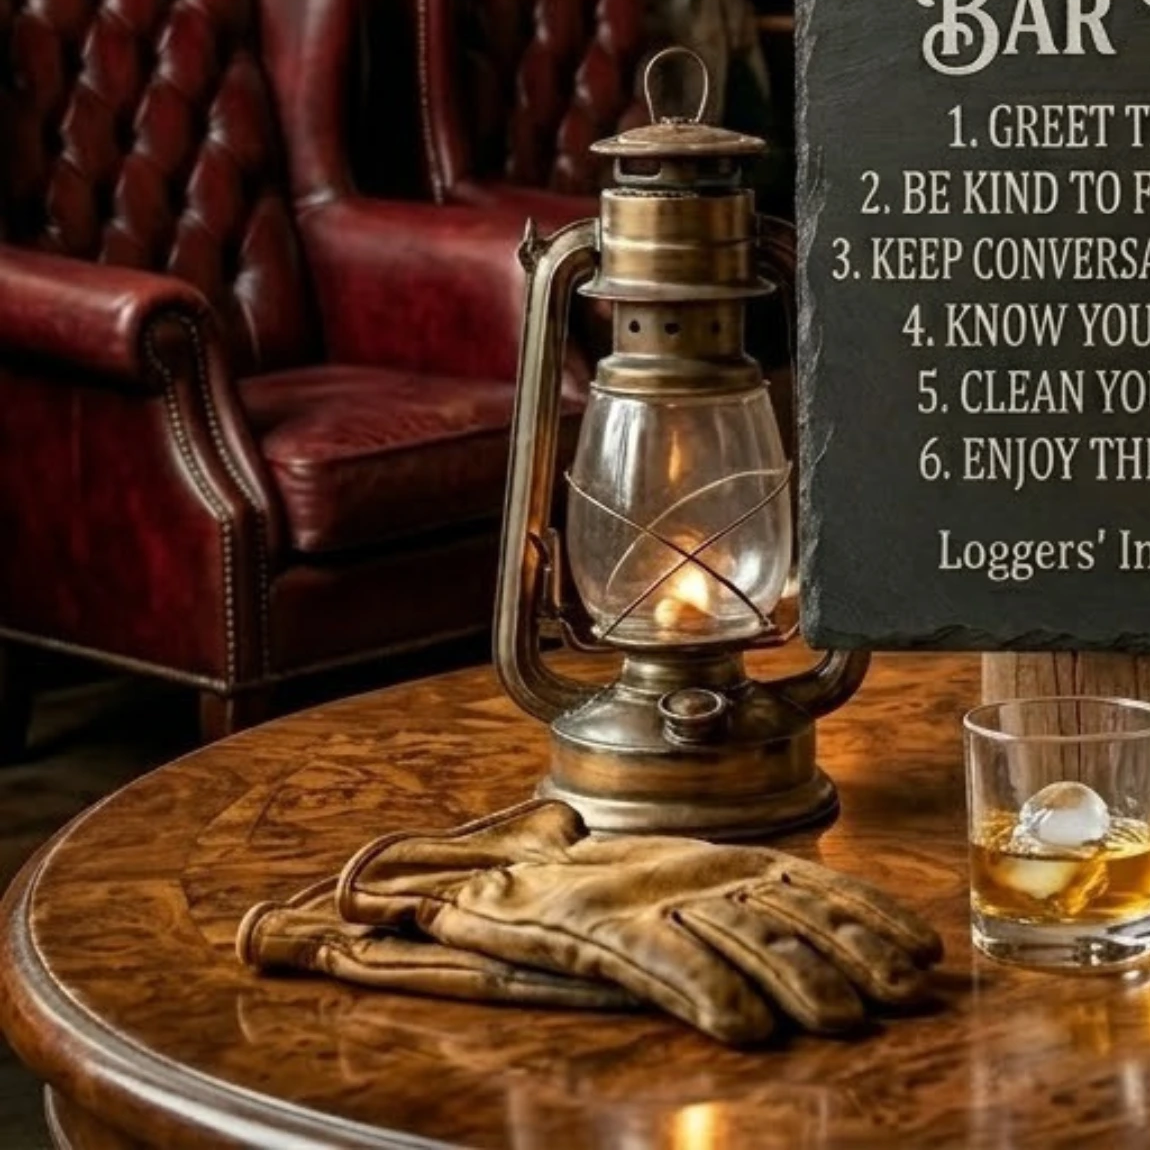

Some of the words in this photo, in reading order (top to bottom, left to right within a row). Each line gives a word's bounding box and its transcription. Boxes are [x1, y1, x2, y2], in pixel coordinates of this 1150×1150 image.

[947, 104, 978, 148] 1.
[988, 103, 1115, 149] GREET
[859, 169, 891, 215] 2.
[902, 170, 951, 215] BE
[962, 170, 1059, 215] KIND
[1068, 170, 1122, 215] TO
[832, 236, 861, 281] 3.
[870, 237, 963, 280] KEEP
[902, 303, 935, 347] 4.
[945, 303, 1069, 347] KNOW
[917, 368, 948, 414] 5.
[960, 369, 1085, 414] CLEAN
[919, 436, 951, 481] 6.
[962, 437, 1081, 491] ENJOY
